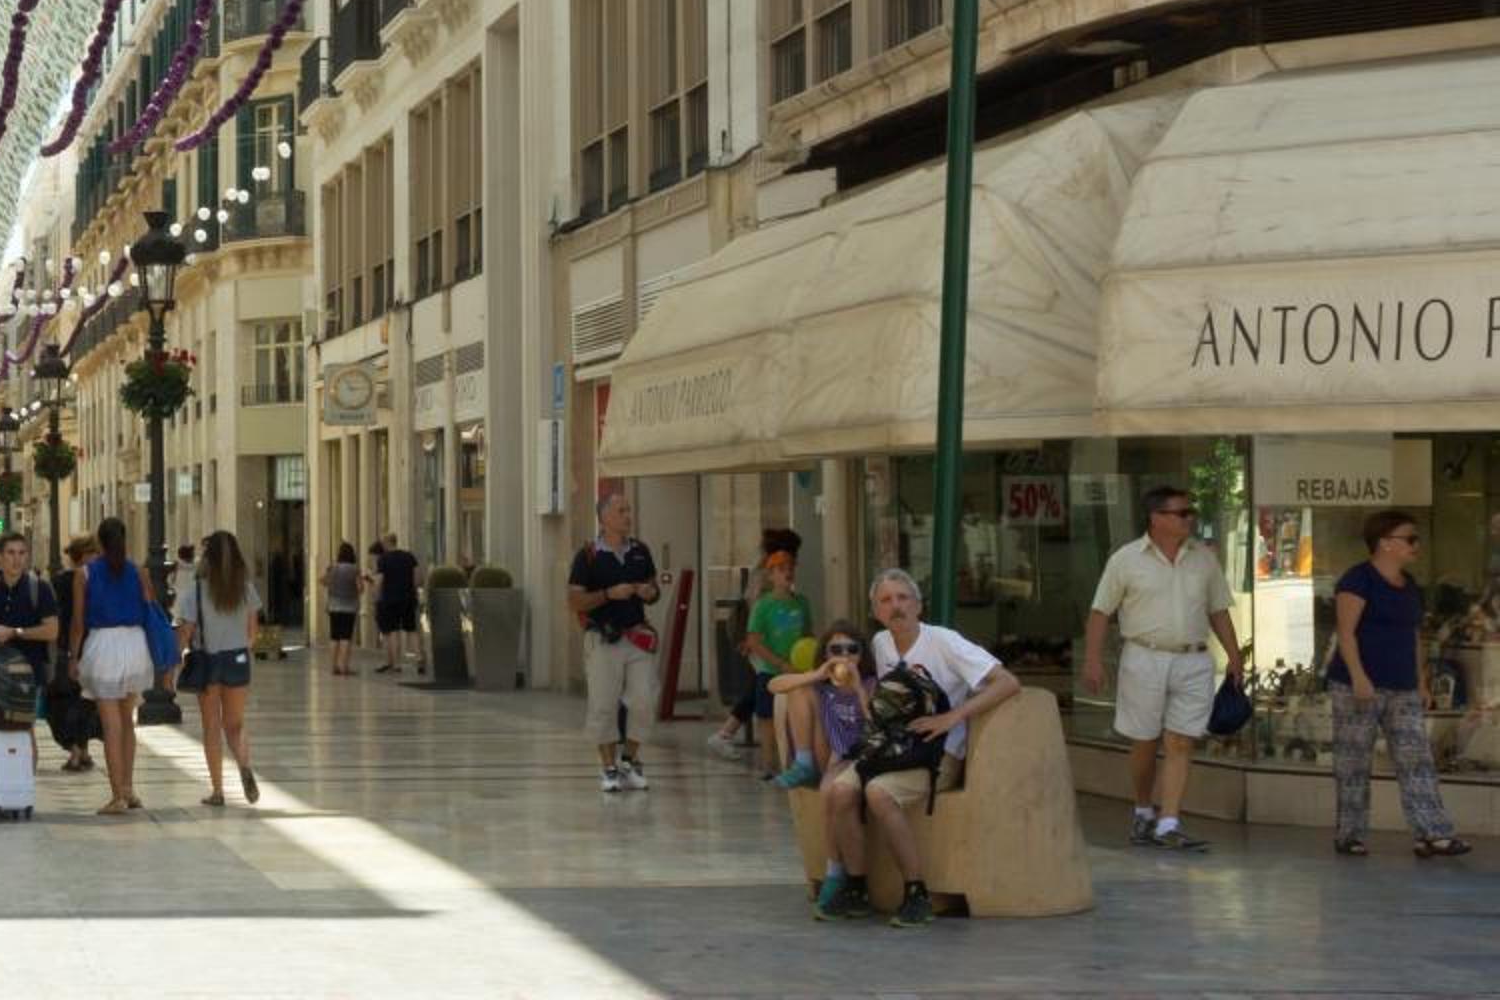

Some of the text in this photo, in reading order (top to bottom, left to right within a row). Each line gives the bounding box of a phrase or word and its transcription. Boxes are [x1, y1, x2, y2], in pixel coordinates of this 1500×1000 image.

[1192, 298, 1454, 366] ANTONIO
[1009, 483, 1061, 519] 50%
[1297, 478, 1390, 501] REBAJAS
